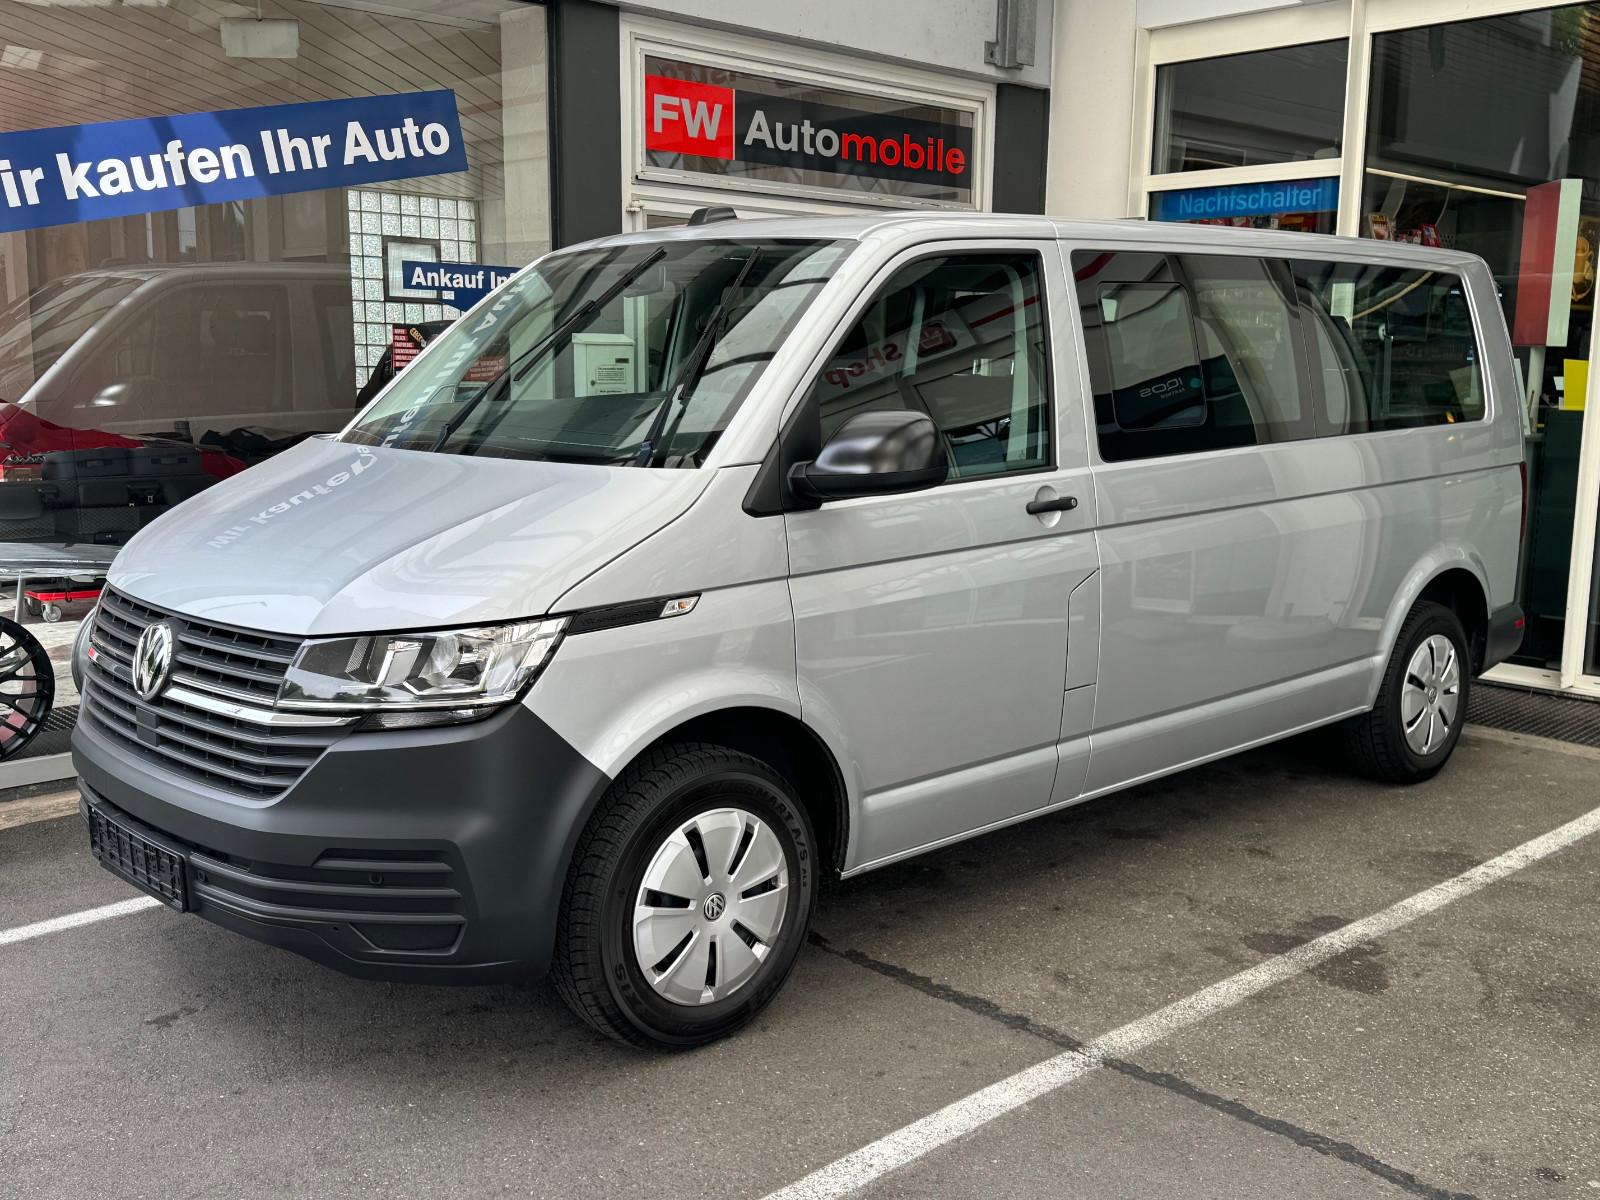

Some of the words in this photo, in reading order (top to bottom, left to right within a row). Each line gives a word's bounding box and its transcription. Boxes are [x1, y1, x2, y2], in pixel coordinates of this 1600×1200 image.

[654, 93, 723, 141] FW
[743, 109, 966, 175] Automobile
[0, 159, 45, 208] ir
[55, 139, 255, 200] kaufen
[260, 128, 332, 175] Ihr
[343, 117, 450, 166] Auto
[1178, 185, 1323, 215] Nachtschalter
[410, 266, 485, 289] Ankauf
